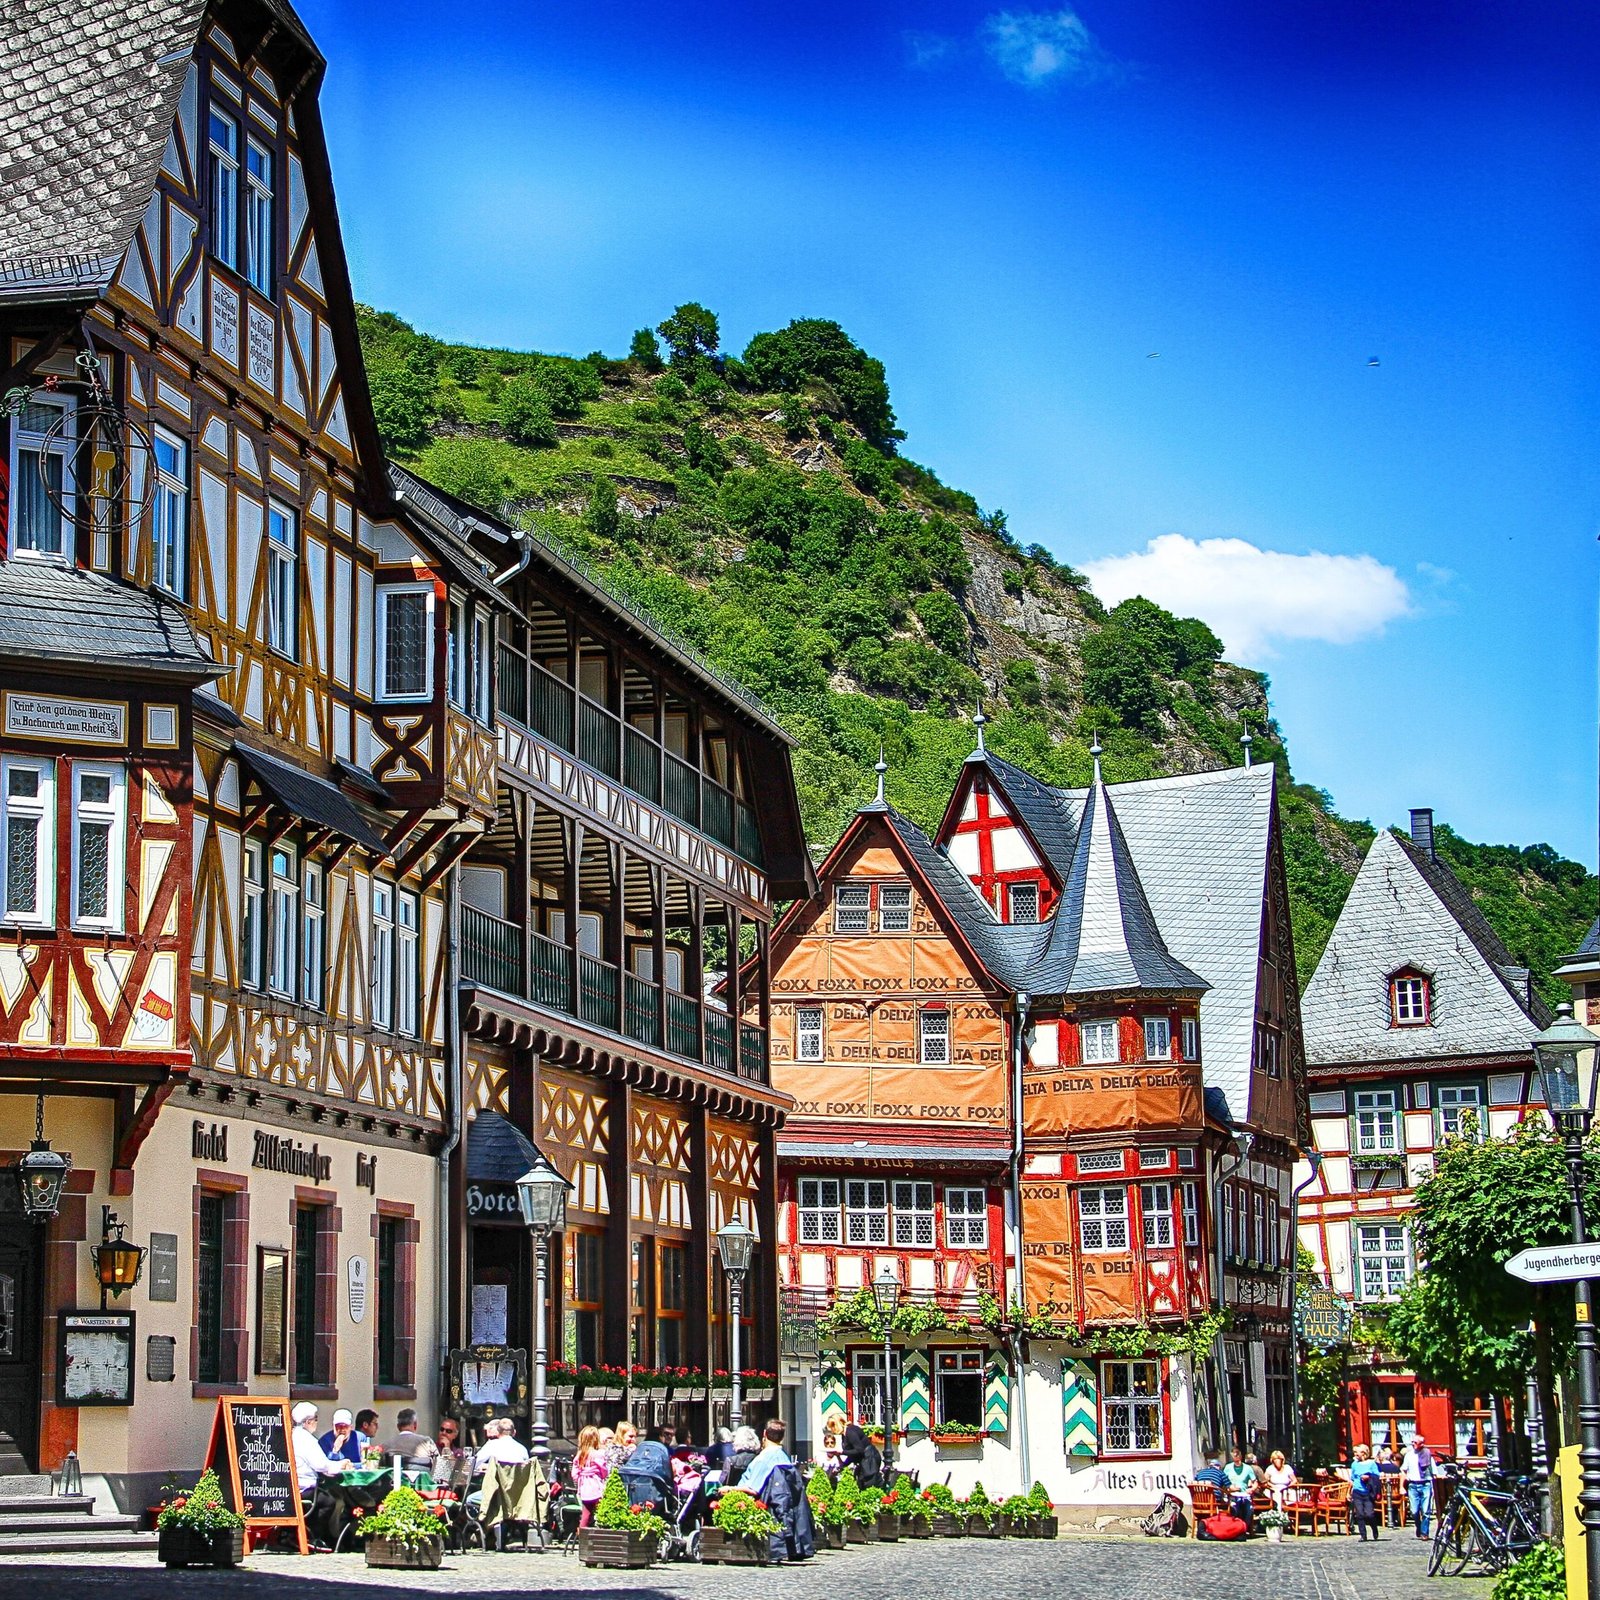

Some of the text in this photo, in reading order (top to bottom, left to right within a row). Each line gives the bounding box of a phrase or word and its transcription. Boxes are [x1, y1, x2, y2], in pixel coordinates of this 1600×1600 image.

[37, 703, 52, 714] den
[11, 716, 106, 734] zu Bacharach am Rhein
[917, 921, 941, 932] DEL
[817, 978, 857, 990] FOXX
[863, 978, 902, 990] FOXX
[956, 977, 978, 989] FO
[841, 1046, 880, 1058] DELTA
[887, 1047, 915, 1059] DELT
[1023, 1082, 1047, 1095] ELTA
[1052, 1078, 1094, 1092] DELTA
[1100, 1075, 1142, 1090] DELTA
[1146, 1075, 1180, 1087] DELTA
[792, 1101, 820, 1113] OXX
[826, 1102, 866, 1115] FOXX
[873, 1103, 913, 1116] FOXX
[920, 1105, 961, 1118] FOXX
[192, 1120, 378, 1196] Hotel Altkölnischer Hof
[1102, 1261, 1134, 1274] DELT
[1524, 1253, 1600, 1271] Jugendherberge
[1303, 1311, 1339, 1323] ALTES
[1304, 1324, 1340, 1336] HAUS
[250, 1426, 264, 1436] mit
